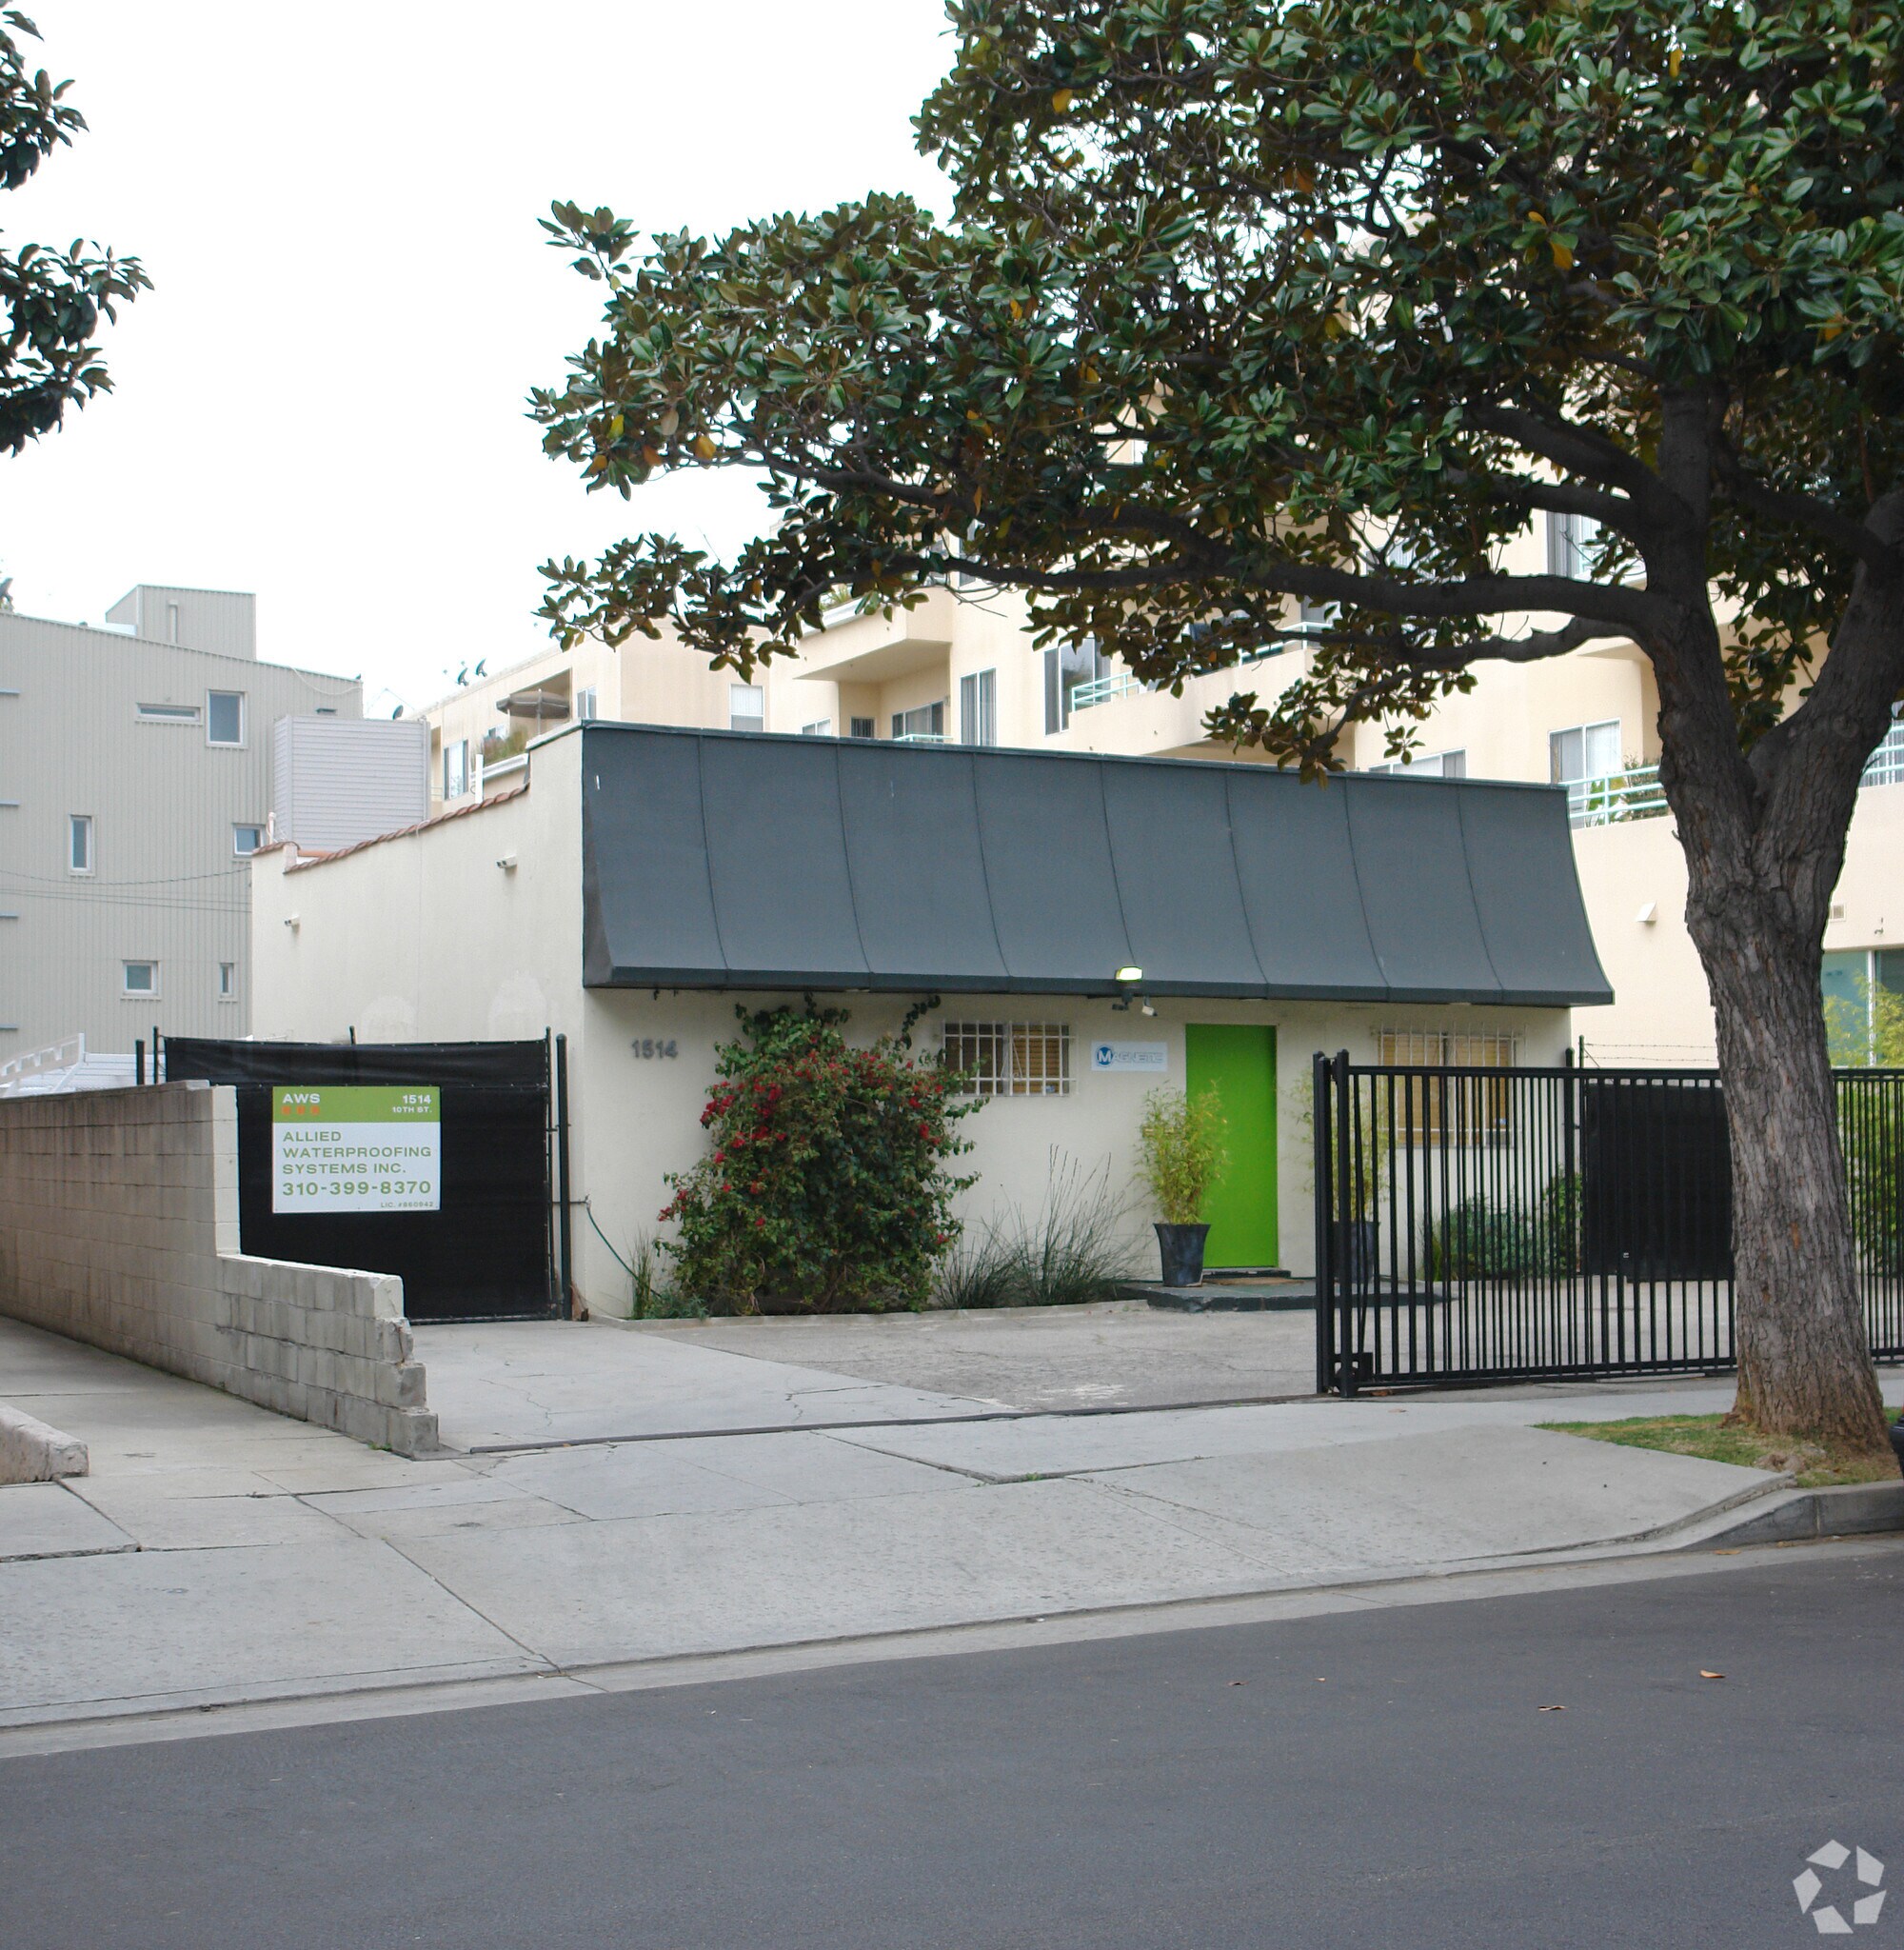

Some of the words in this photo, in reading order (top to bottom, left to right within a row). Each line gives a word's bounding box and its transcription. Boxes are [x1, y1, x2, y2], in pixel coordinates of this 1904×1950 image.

[631, 1039, 679, 1059] 1514
[282, 1093, 321, 1104] AWS
[402, 1094, 431, 1104] 1514
[283, 1131, 342, 1143] ALLIED
[282, 1146, 431, 1159] WATERPROOFING
[282, 1164, 367, 1174] SYSTEMS
[373, 1163, 407, 1173] INC.
[282, 1181, 431, 1196] 310-399-8370
